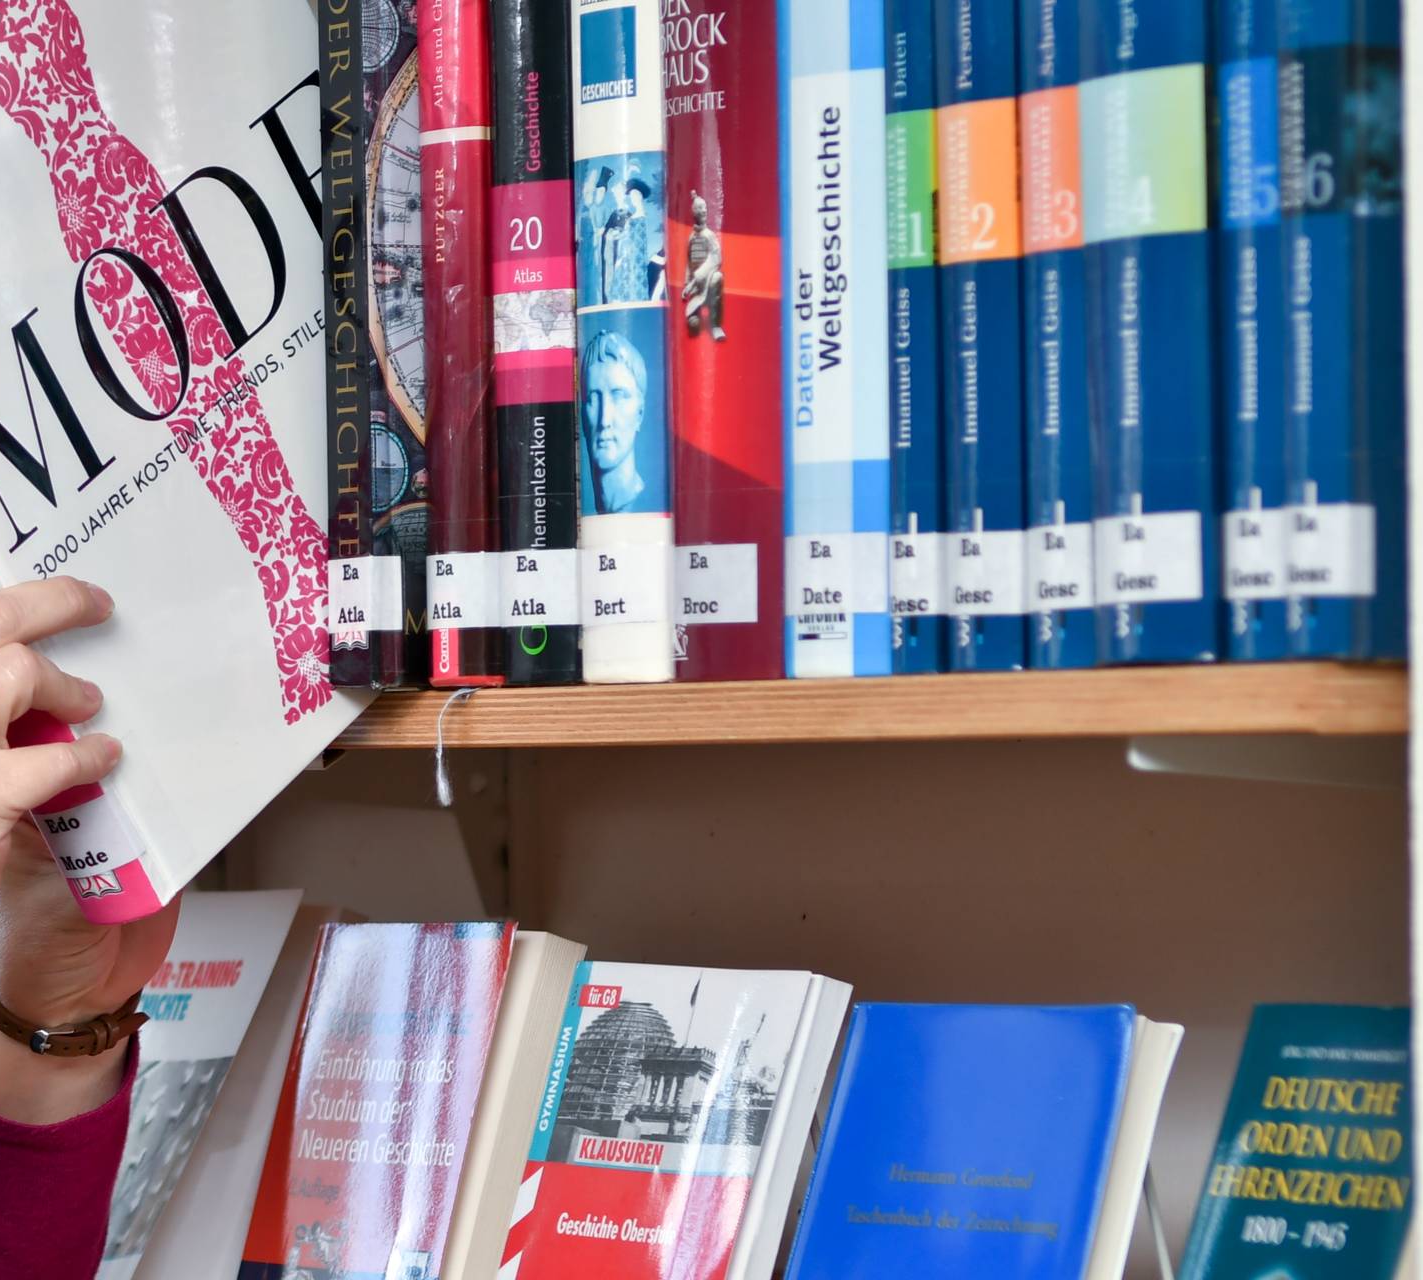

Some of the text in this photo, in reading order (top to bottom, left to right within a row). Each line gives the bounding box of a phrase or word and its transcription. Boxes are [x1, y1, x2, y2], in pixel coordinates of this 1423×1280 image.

[432, 27, 443, 60] und
[893, 31, 907, 98] Daten
[433, 66, 444, 109] Atlas
[581, 79, 634, 102] GESCHICHTE
[664, 91, 726, 118] SCHICHTE
[524, 71, 541, 172] Geschichte
[1251, 164, 1277, 217] 5
[1305, 152, 1334, 206] 6
[434, 167, 446, 264] PUTZGER
[1053, 190, 1078, 239] 3
[1131, 175, 1156, 226] 4
[508, 215, 543, 252] 20
[817, 105, 847, 372] Weltgeschichte
[908, 211, 926, 258] 1
[971, 202, 997, 251] 2
[513, 267, 544, 284] Atlas
[330, 90, 360, 557] WELTGESCHICHTE
[794, 268, 814, 428] Daten der
[960, 280, 978, 443] Imanuel Geiss
[1041, 269, 1059, 435] Imanuel Geiss
[895, 287, 911, 448] Imanuel Geiss
[33, 534, 78, 580] 3000
[80, 484, 135, 543] JAHRE
[214, 354, 284, 416] TRENDS,
[530, 415, 546, 549] hemenlexikon
[809, 541, 832, 559] Ea
[893, 541, 915, 559] Ea
[961, 538, 981, 557] Ea
[1044, 532, 1065, 551] Ea
[342, 564, 359, 581] Ea
[435, 559, 454, 577] Ea
[516, 555, 538, 573] Ea
[599, 554, 617, 572] Ea
[689, 552, 709, 570] Ea
[802, 587, 843, 605] Date
[954, 586, 993, 604] Gesc
[1038, 580, 1079, 599] Gesc
[1115, 571, 1158, 591] Gesc
[338, 606, 365, 624] Atla
[432, 601, 462, 620] Atla
[511, 598, 546, 617] Atla
[594, 598, 626, 617] Bert
[683, 597, 719, 615] Broc
[439, 629, 450, 673] Cornel
[45, 816, 81, 834] Edo
[60, 850, 109, 871] Mode
[587, 987, 617, 1006] für G8
[316, 1049, 456, 1090] Einführung in das
[538, 1025, 573, 1132] GYMNASIUM
[306, 1089, 412, 1125] Studium der
[1261, 1075, 1404, 1116] DEUTSCHE
[297, 1129, 455, 1167] Neueren Geschichte
[579, 1137, 665, 1166] KLAUSUREN
[1240, 1119, 1404, 1164] ORDEN UND
[1209, 1164, 1411, 1211] EHRENZEICHEN
[557, 1212, 619, 1240] Geschichte
[1241, 1215, 1288, 1245] 1800
[1301, 1219, 1350, 1251] 1945
